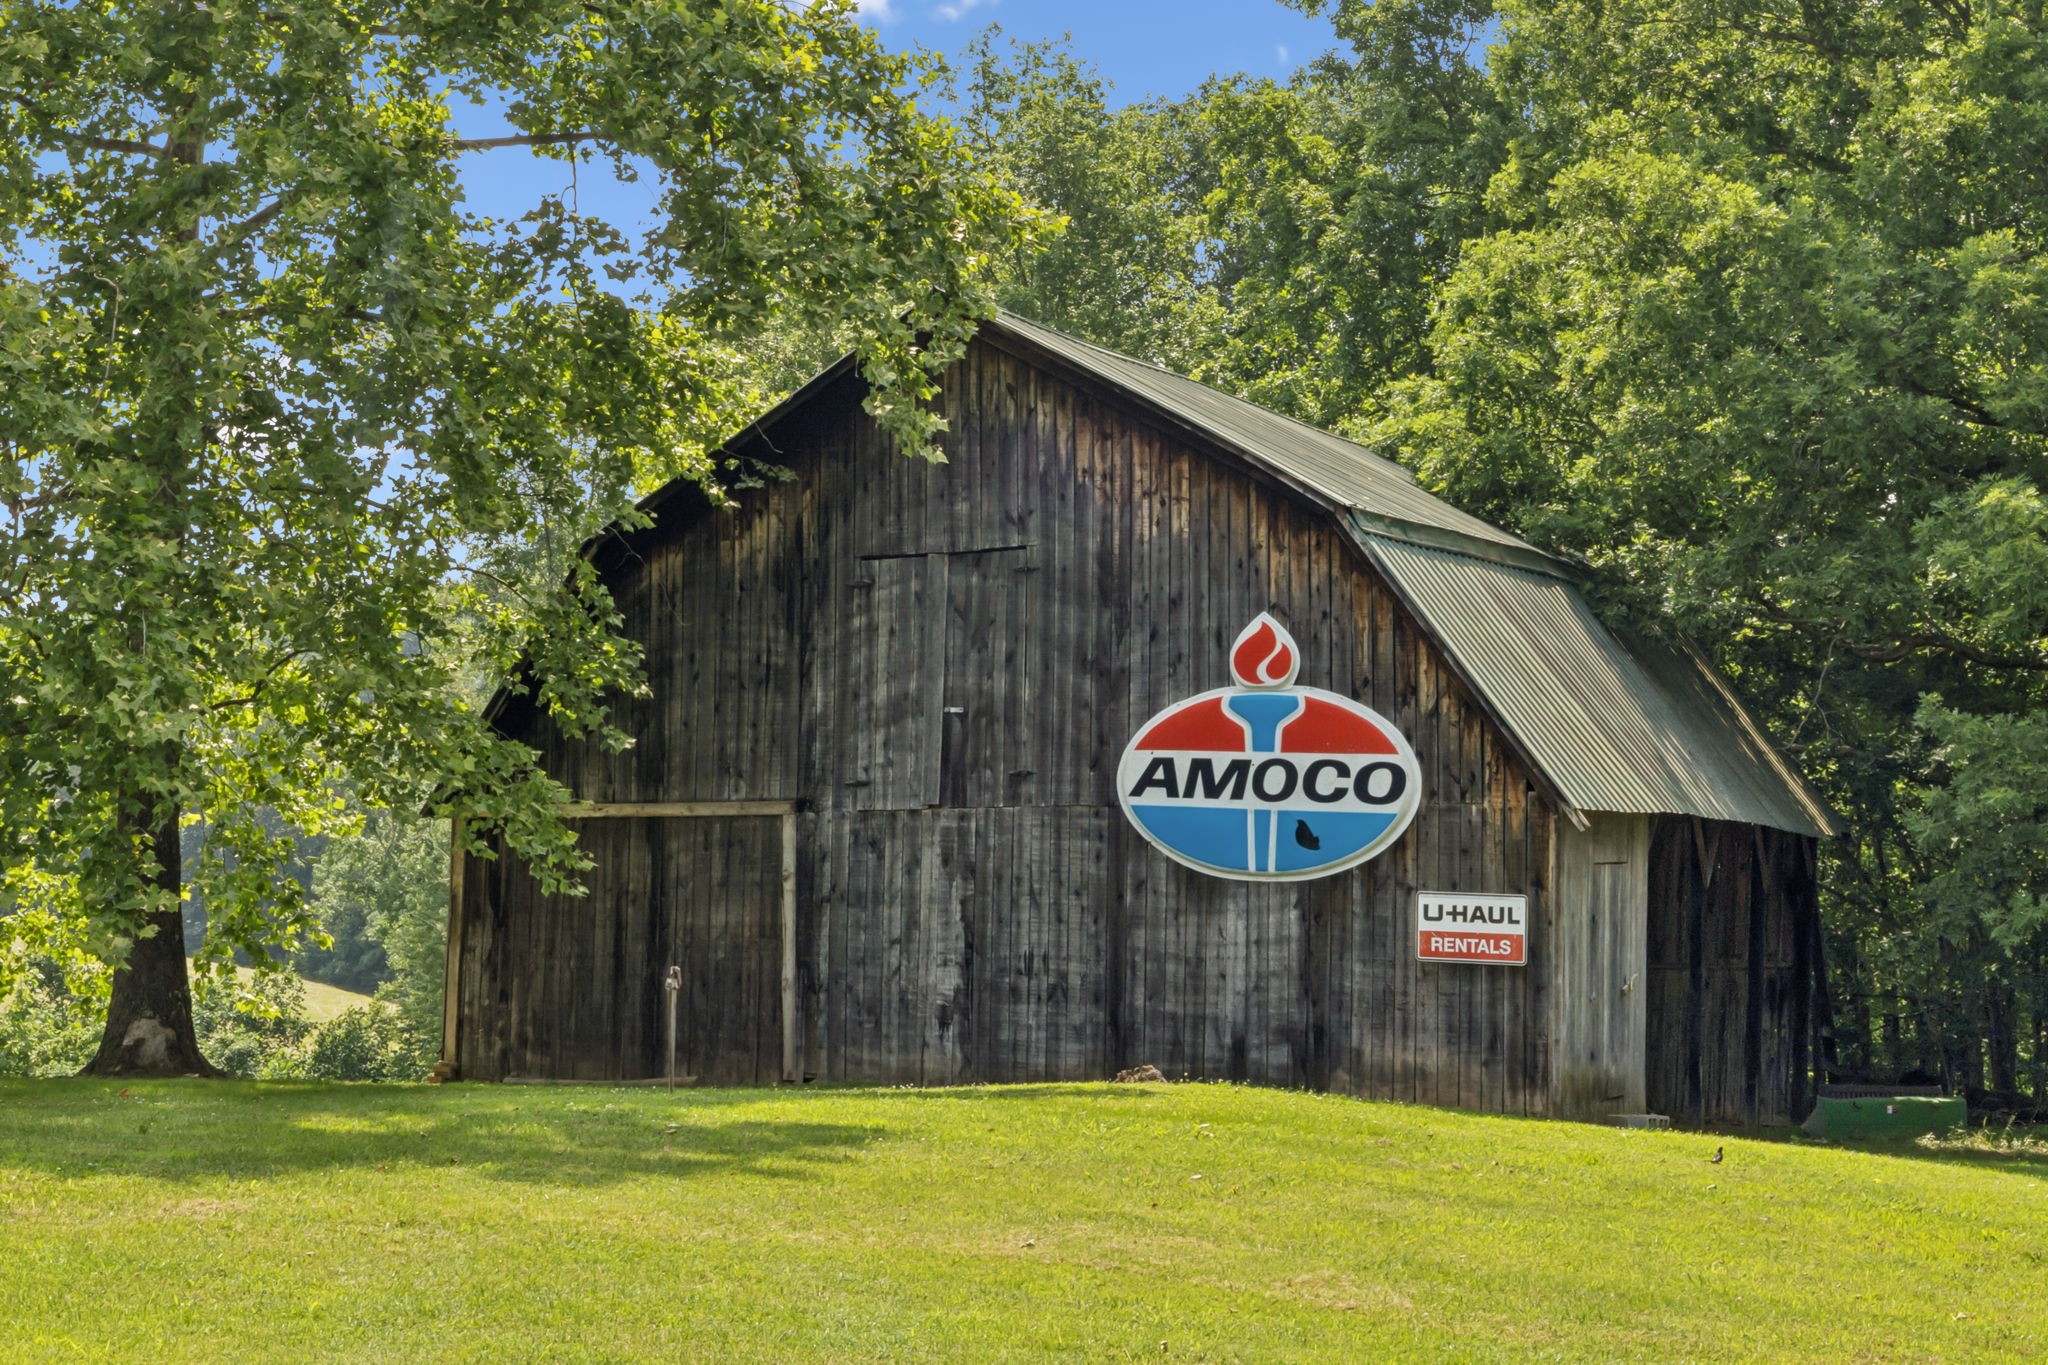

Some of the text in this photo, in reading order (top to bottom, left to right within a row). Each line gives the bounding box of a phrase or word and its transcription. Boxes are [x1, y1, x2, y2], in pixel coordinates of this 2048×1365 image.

[1129, 757, 1407, 805] AMOCO
[1423, 904, 1520, 925] U-HAUL
[1430, 936, 1512, 955] RENTALS
